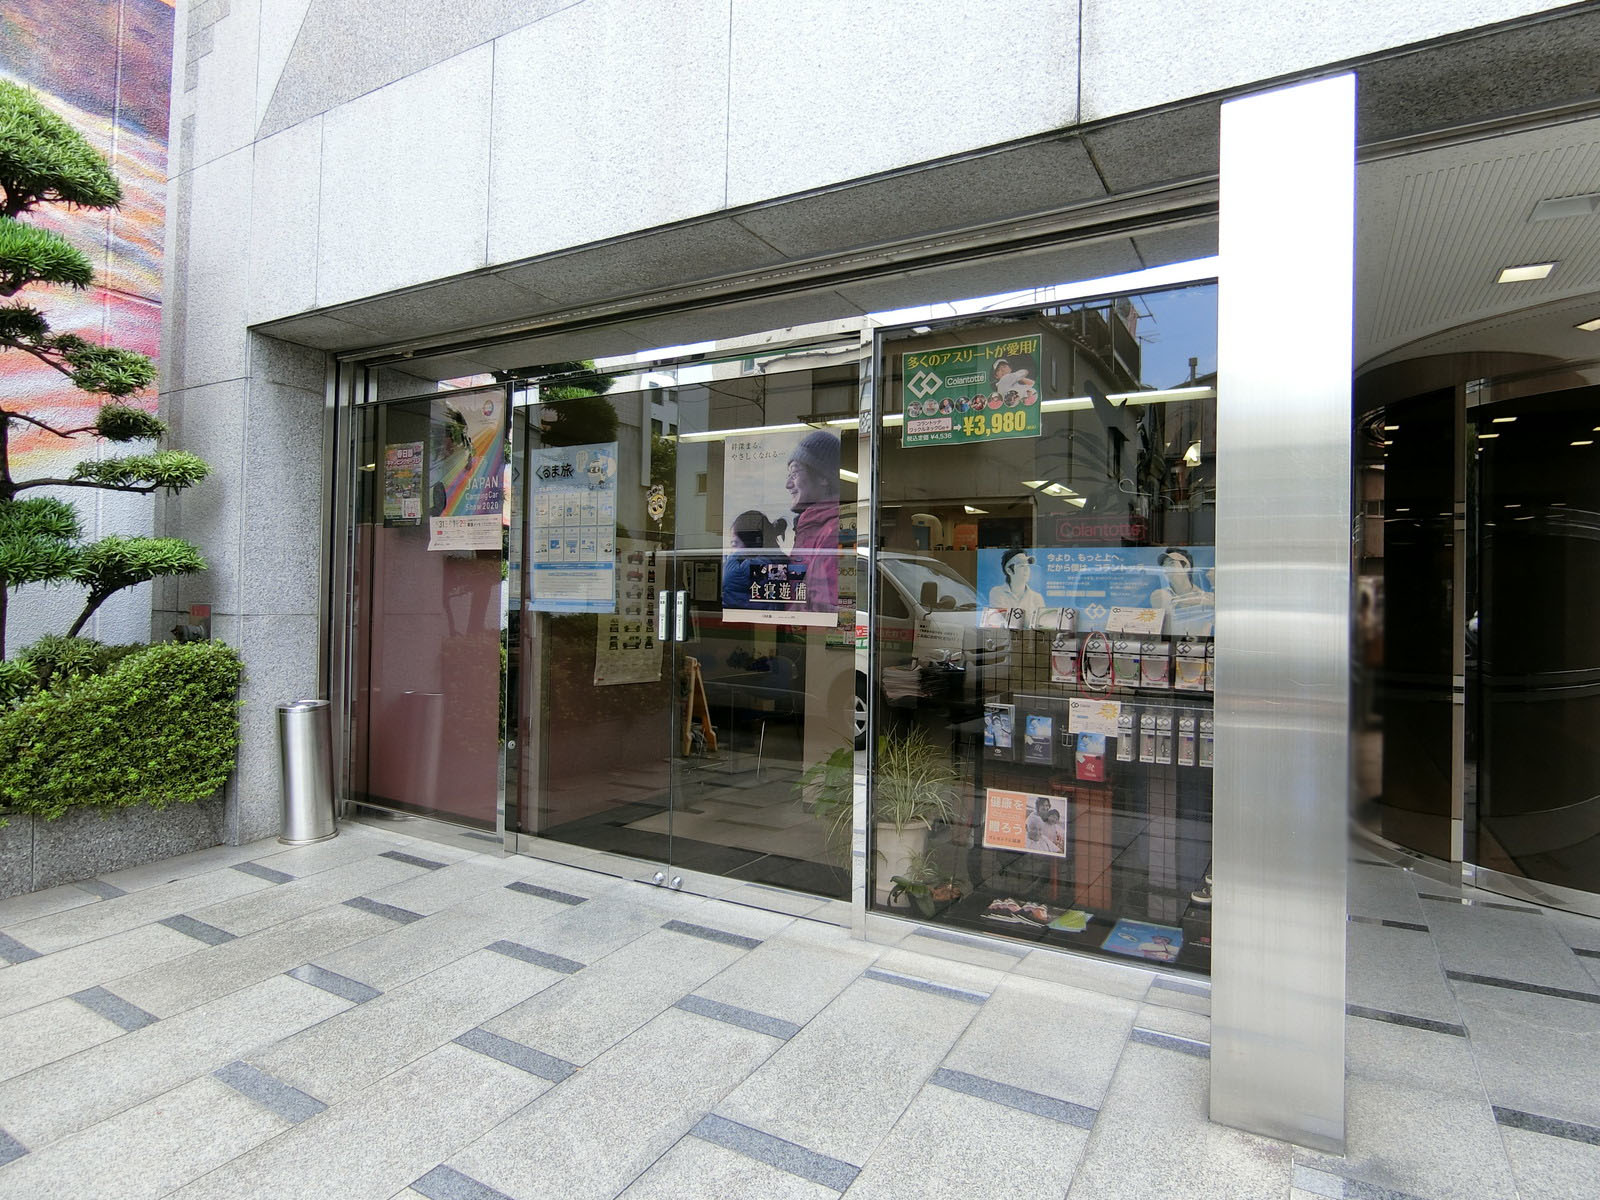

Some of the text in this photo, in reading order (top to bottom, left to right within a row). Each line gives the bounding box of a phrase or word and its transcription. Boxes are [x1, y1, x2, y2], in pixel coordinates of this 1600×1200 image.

[963, 411, 1026, 437] ¥3,980
[535, 463, 575, 480] くるま旅
[465, 475, 499, 490] JAPAN
[488, 491, 499, 499] Car
[482, 501, 499, 510] 2020
[991, 796, 1024, 810] 健康を
